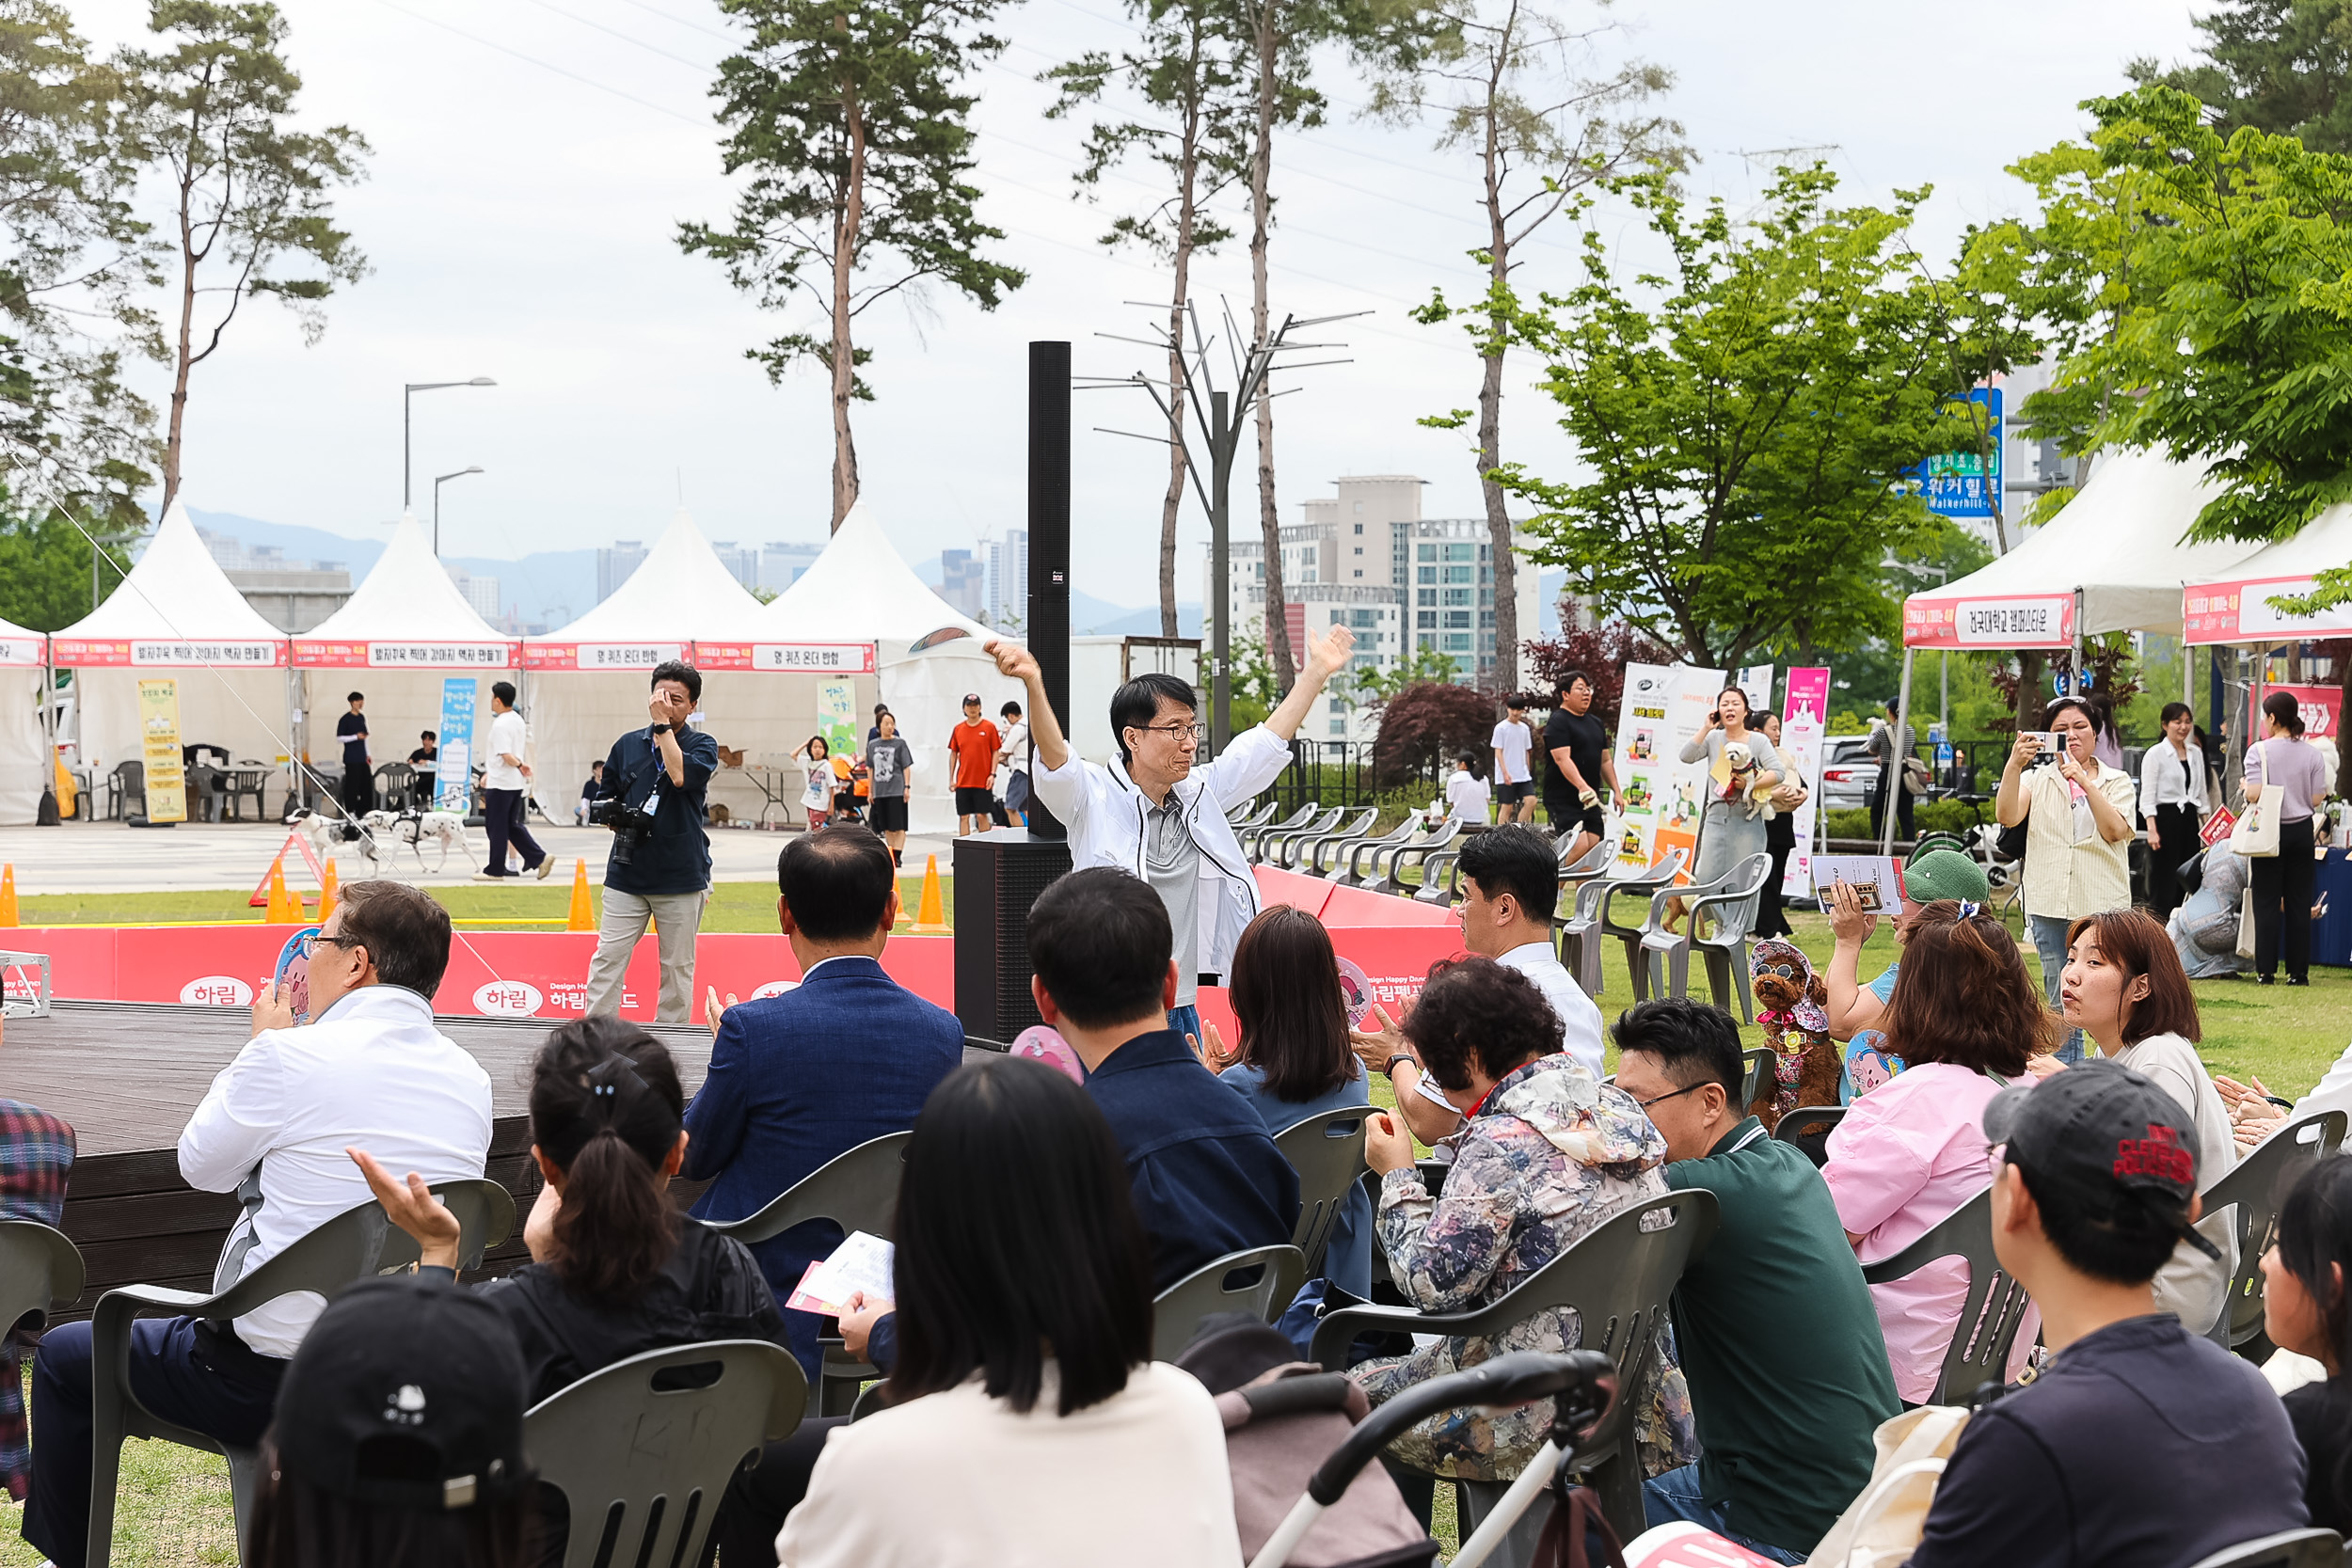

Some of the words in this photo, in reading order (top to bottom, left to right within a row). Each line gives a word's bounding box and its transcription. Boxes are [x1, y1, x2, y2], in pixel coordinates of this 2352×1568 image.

[1969, 610, 2007, 633] 건국대학교
[2010, 609, 2047, 633] 캠퍼스타운
[194, 986, 235, 1006] 하림
[550, 983, 576, 991] Design
[486, 990, 526, 1008] 하림
